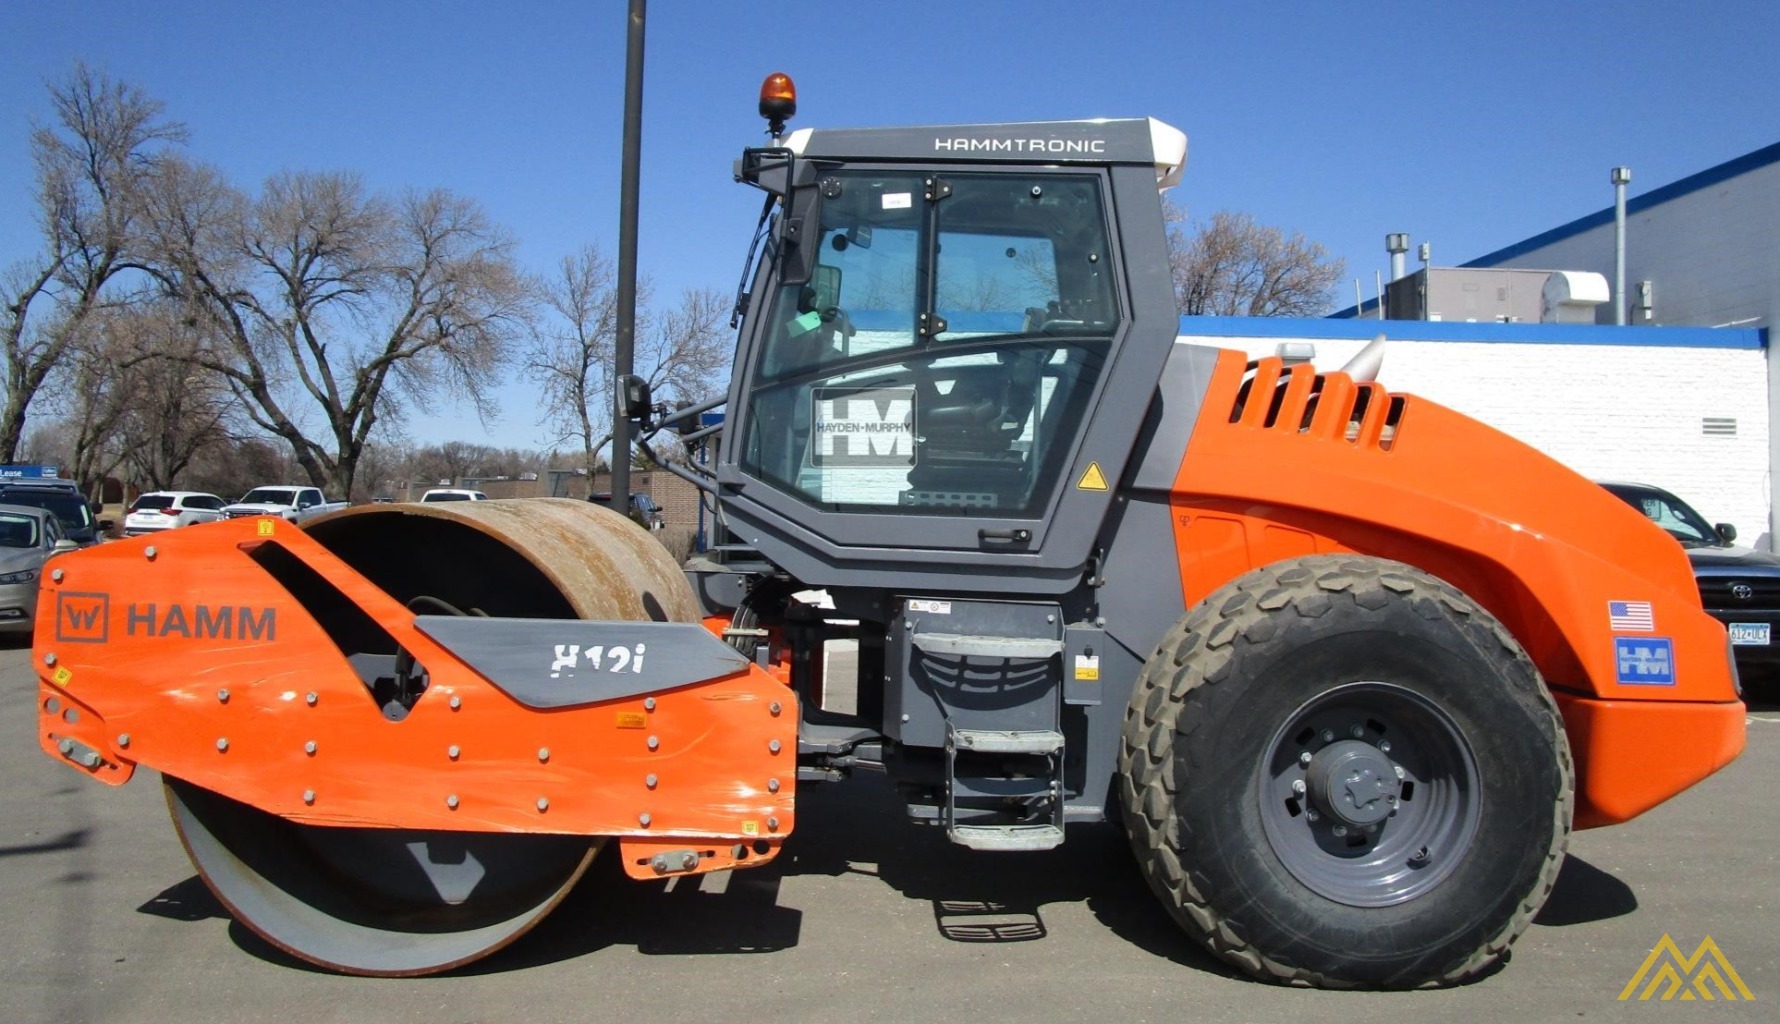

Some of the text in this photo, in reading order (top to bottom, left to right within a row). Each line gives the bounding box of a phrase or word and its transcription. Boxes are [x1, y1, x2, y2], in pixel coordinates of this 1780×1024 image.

[935, 138, 1105, 153] HAMMTRONIC
[816, 422, 911, 433] HAYDEN-MURPHY
[127, 603, 276, 641] HAMM
[550, 643, 646, 679] H12i
